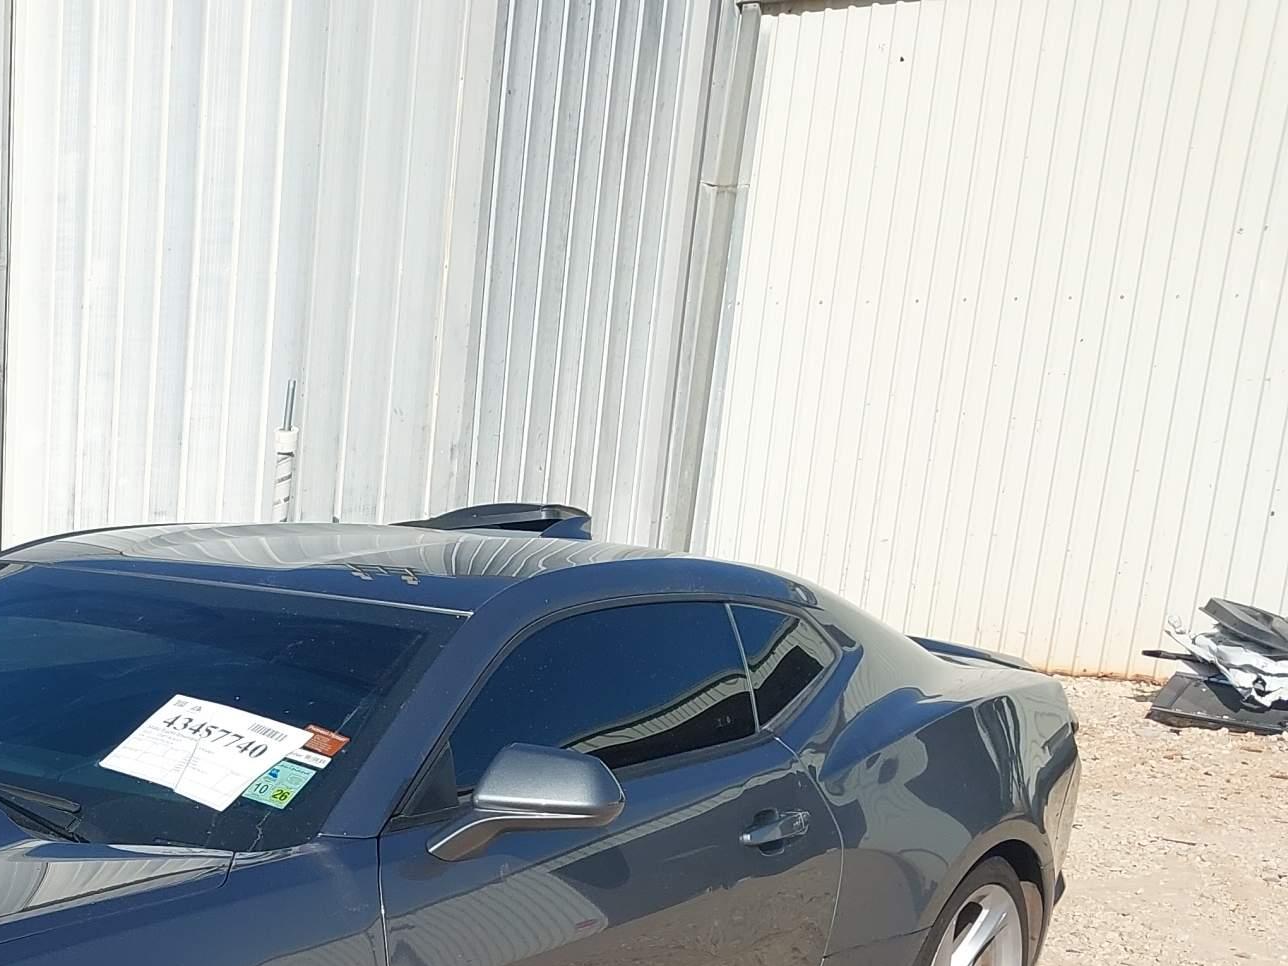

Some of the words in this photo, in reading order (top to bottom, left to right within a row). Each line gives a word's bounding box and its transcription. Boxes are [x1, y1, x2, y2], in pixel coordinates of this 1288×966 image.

[163, 713, 269, 759] 43457740
[253, 782, 269, 794] 10
[271, 789, 290, 801] 26
